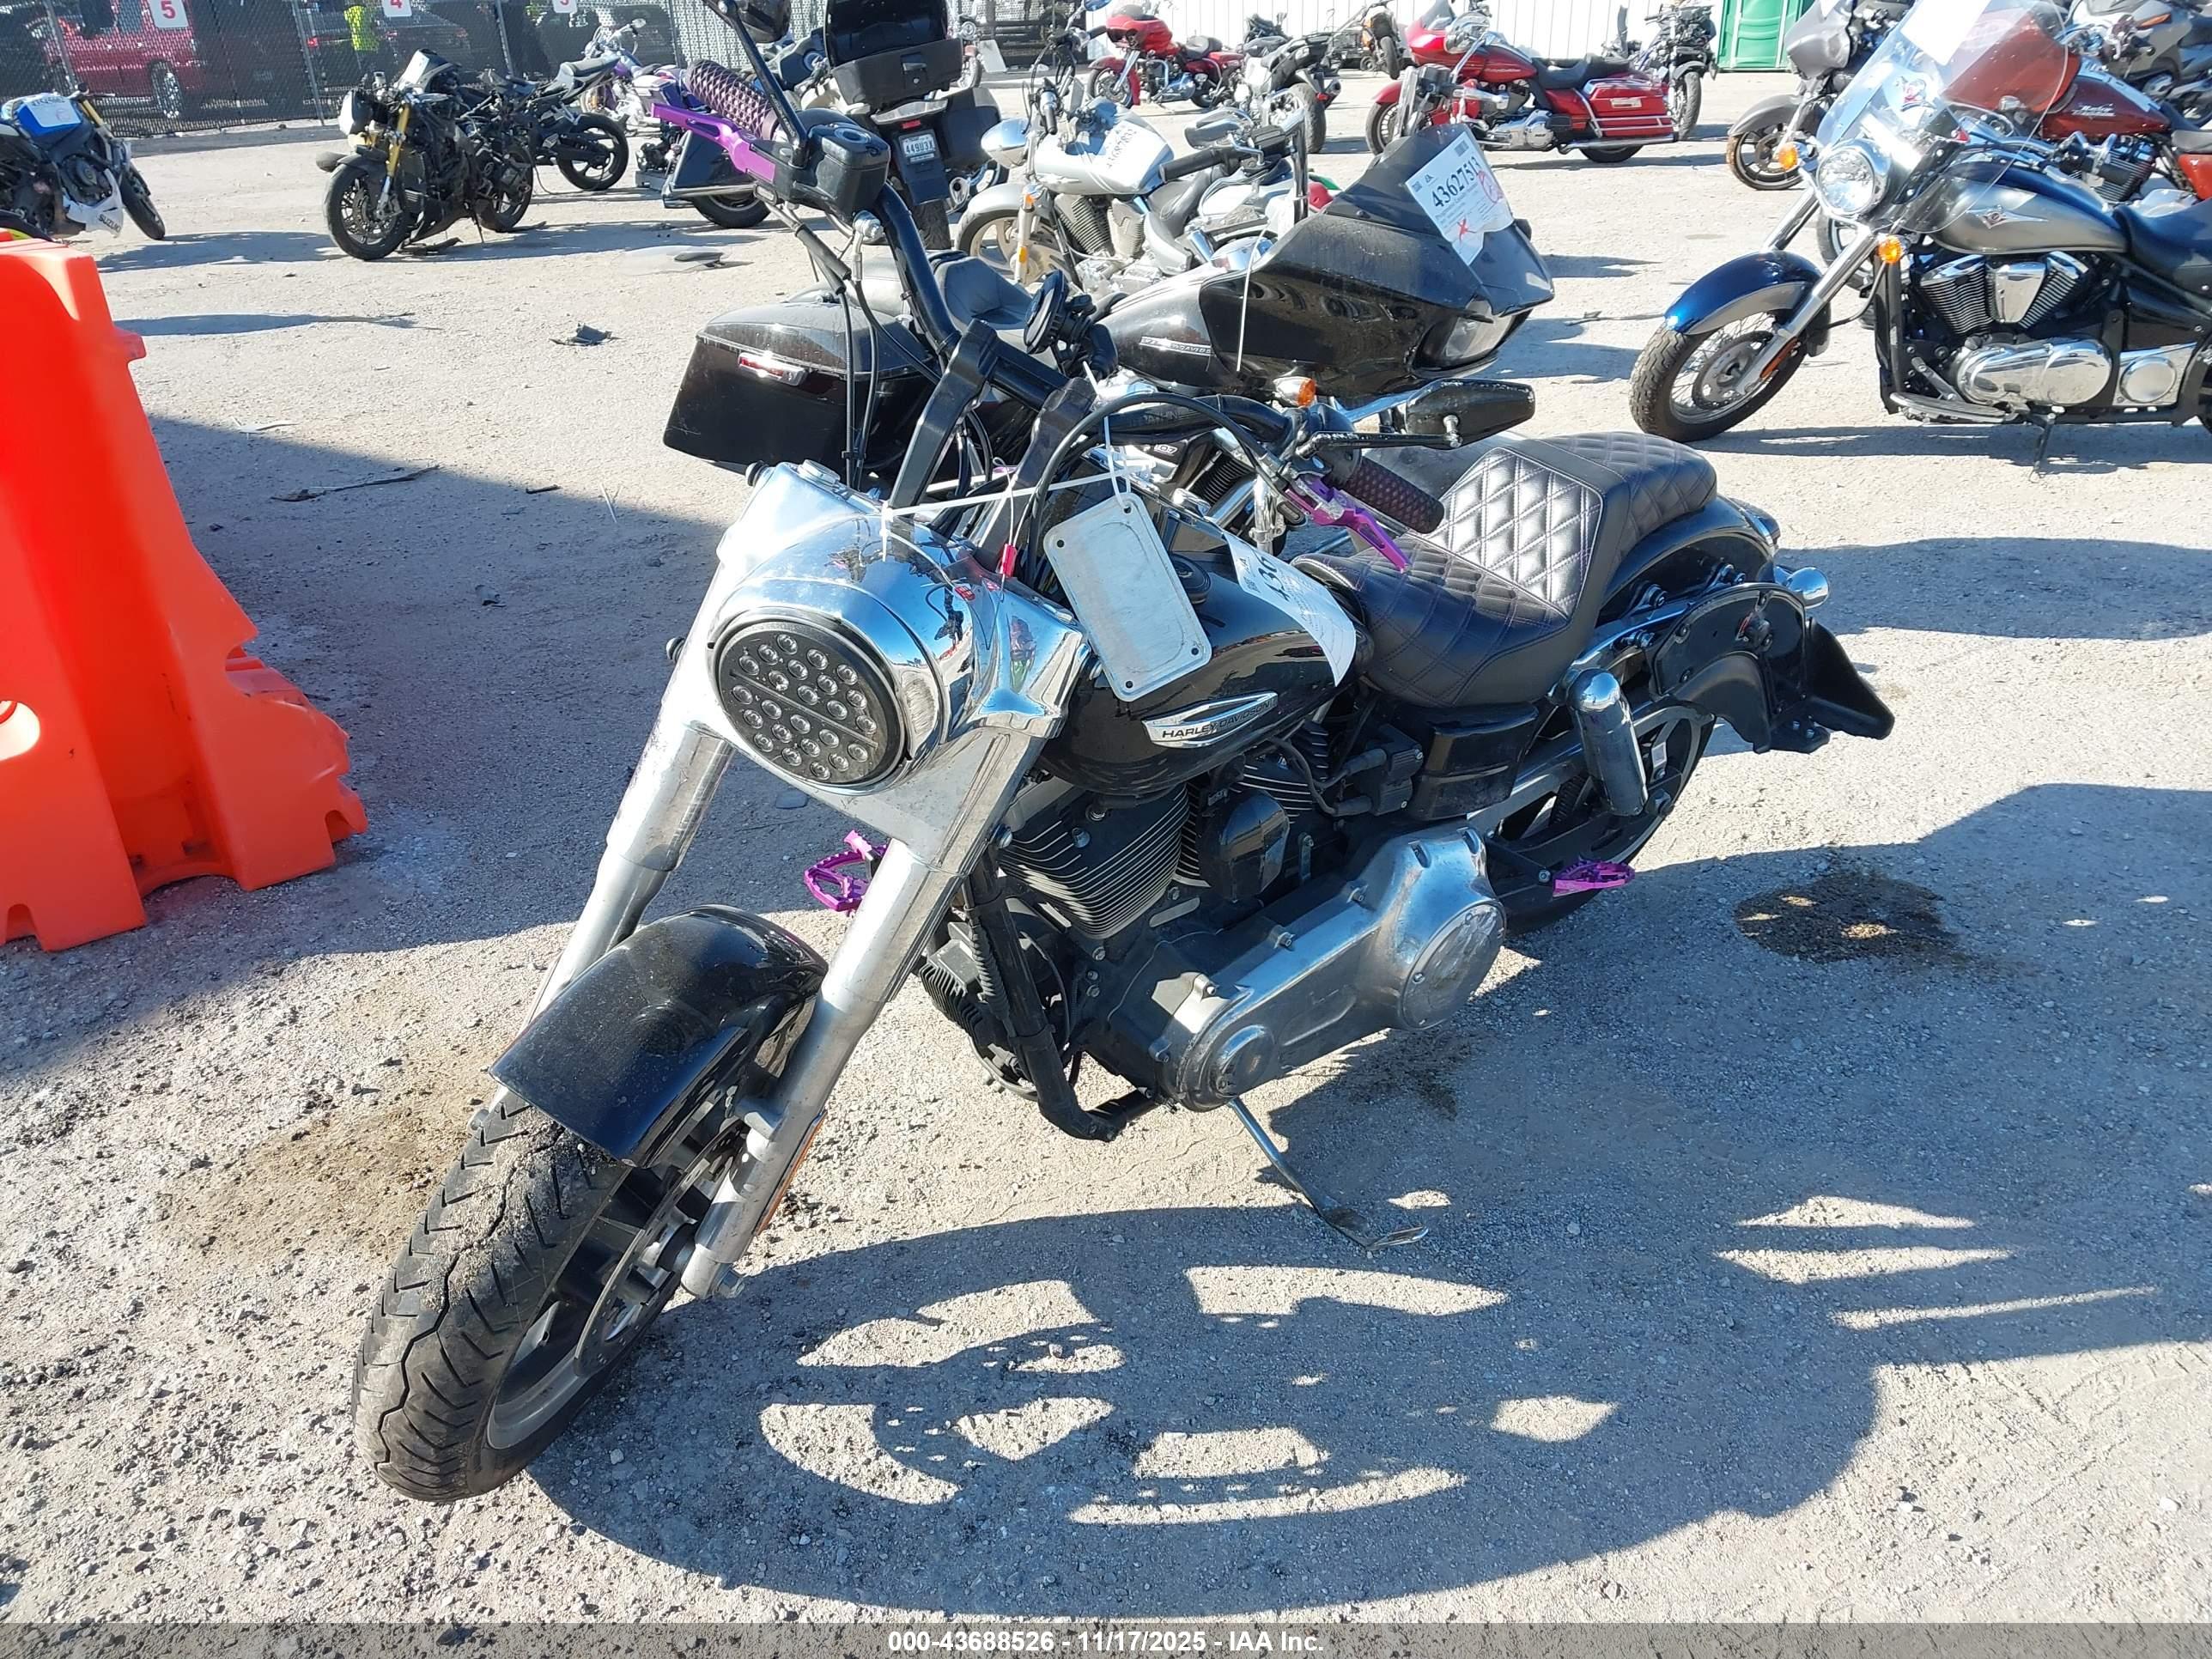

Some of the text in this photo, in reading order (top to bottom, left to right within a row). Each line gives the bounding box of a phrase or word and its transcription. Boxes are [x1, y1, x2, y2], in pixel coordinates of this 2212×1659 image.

[161, 0, 176, 19] 5
[1431, 156, 1482, 208] 43627513
[1162, 700, 1270, 738] HARLEY-DAVIDSON
